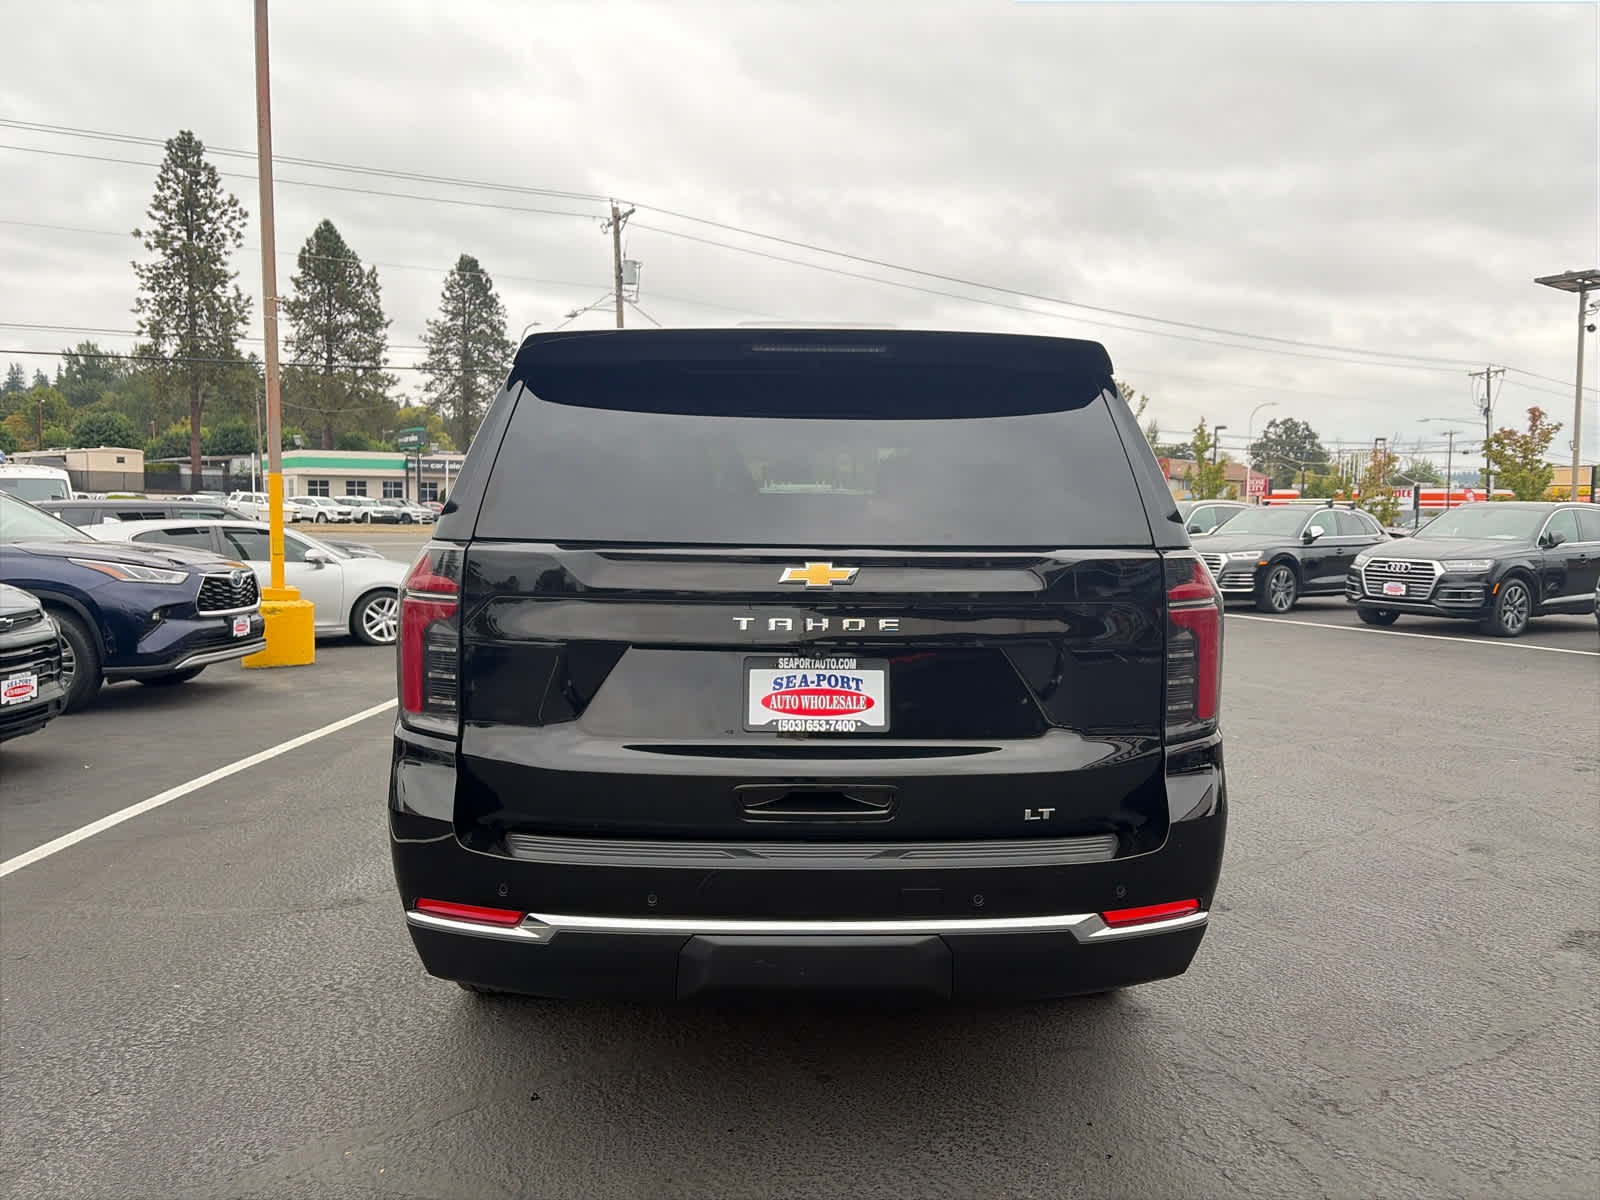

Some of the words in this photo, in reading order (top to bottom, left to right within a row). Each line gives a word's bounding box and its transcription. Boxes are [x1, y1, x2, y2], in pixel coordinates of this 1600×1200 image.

[733, 617, 900, 632] TAHOE
[778, 658, 857, 670] SEAPORTAUTO.COM
[772, 673, 863, 691] SEA-PORT
[769, 695, 799, 710] AUTO
[800, 694, 867, 710] WHOLESALE
[1024, 808, 1056, 820] LT
